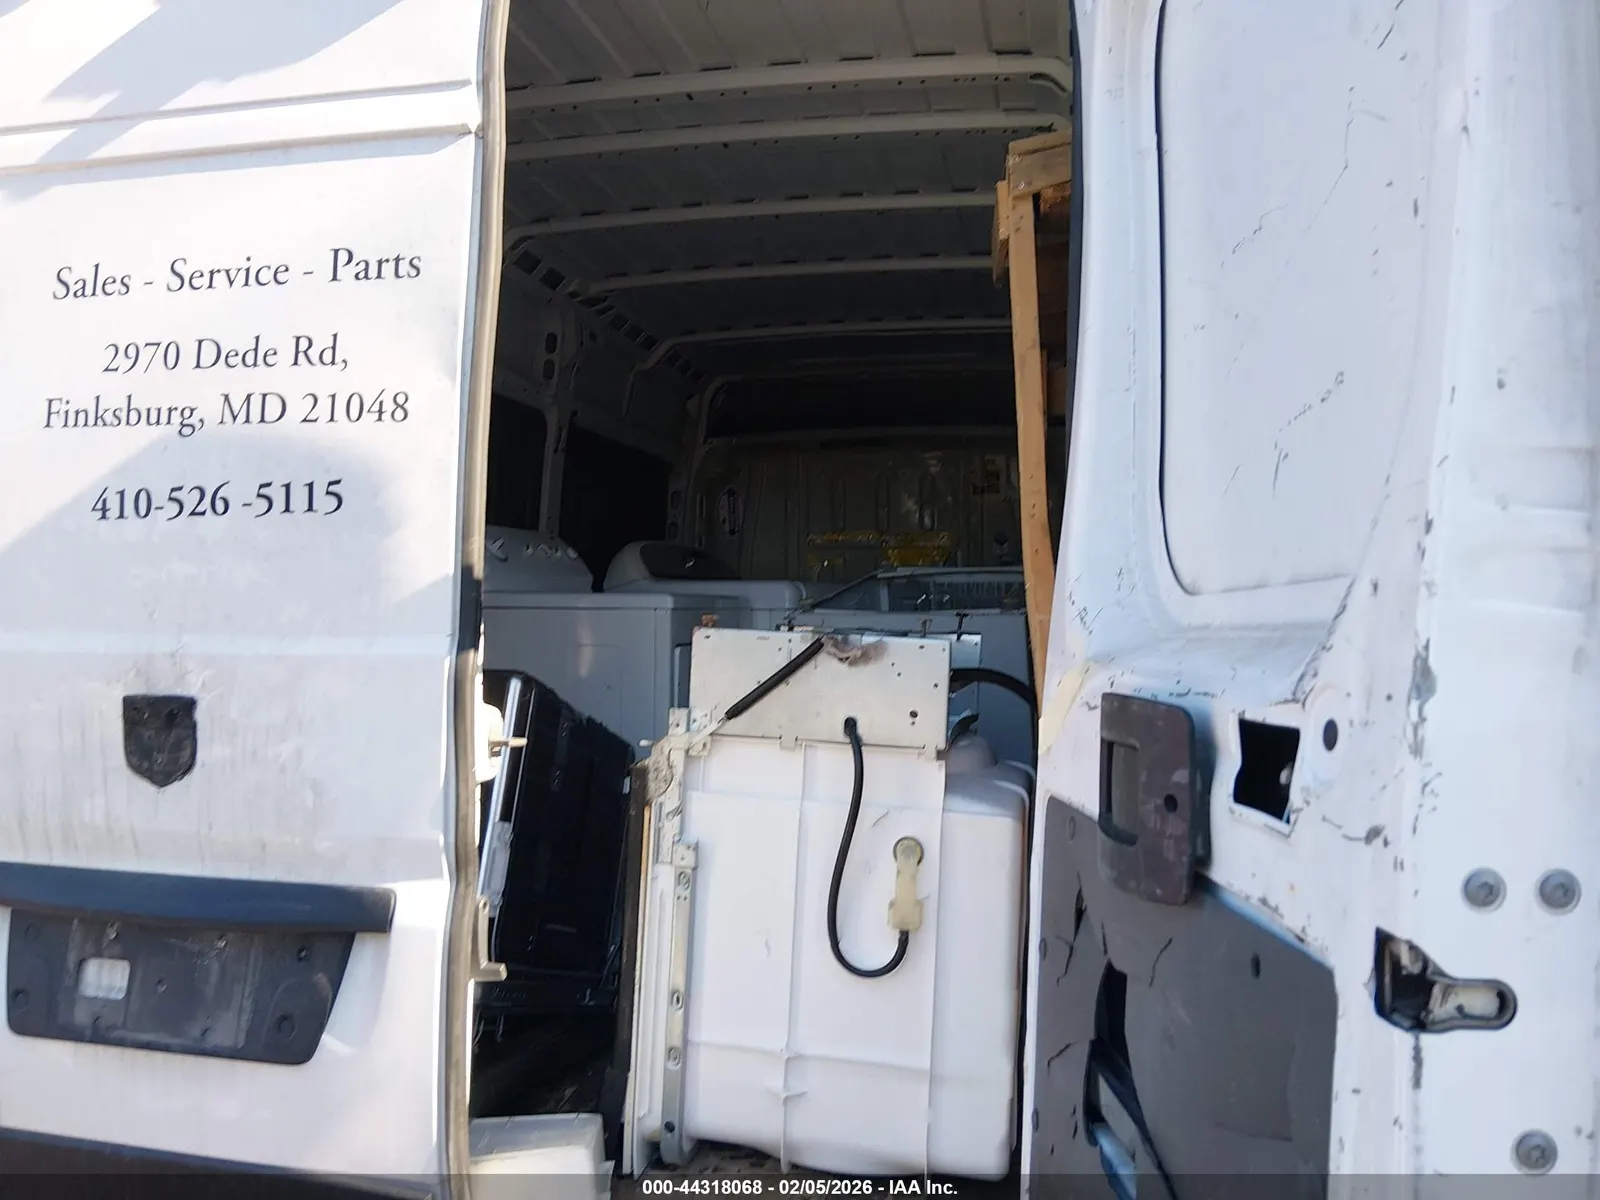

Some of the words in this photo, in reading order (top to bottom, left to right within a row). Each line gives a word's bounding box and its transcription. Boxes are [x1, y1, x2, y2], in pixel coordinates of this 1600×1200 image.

[52, 262, 132, 301] Sales
[166, 255, 290, 293] Service
[327, 247, 422, 284] Parts
[101, 340, 181, 375] 2970
[191, 333, 278, 371] Dede
[289, 331, 348, 372] Rd,
[42, 393, 205, 439] Finksburg,
[217, 391, 288, 426] MD
[299, 387, 410, 424] 21048
